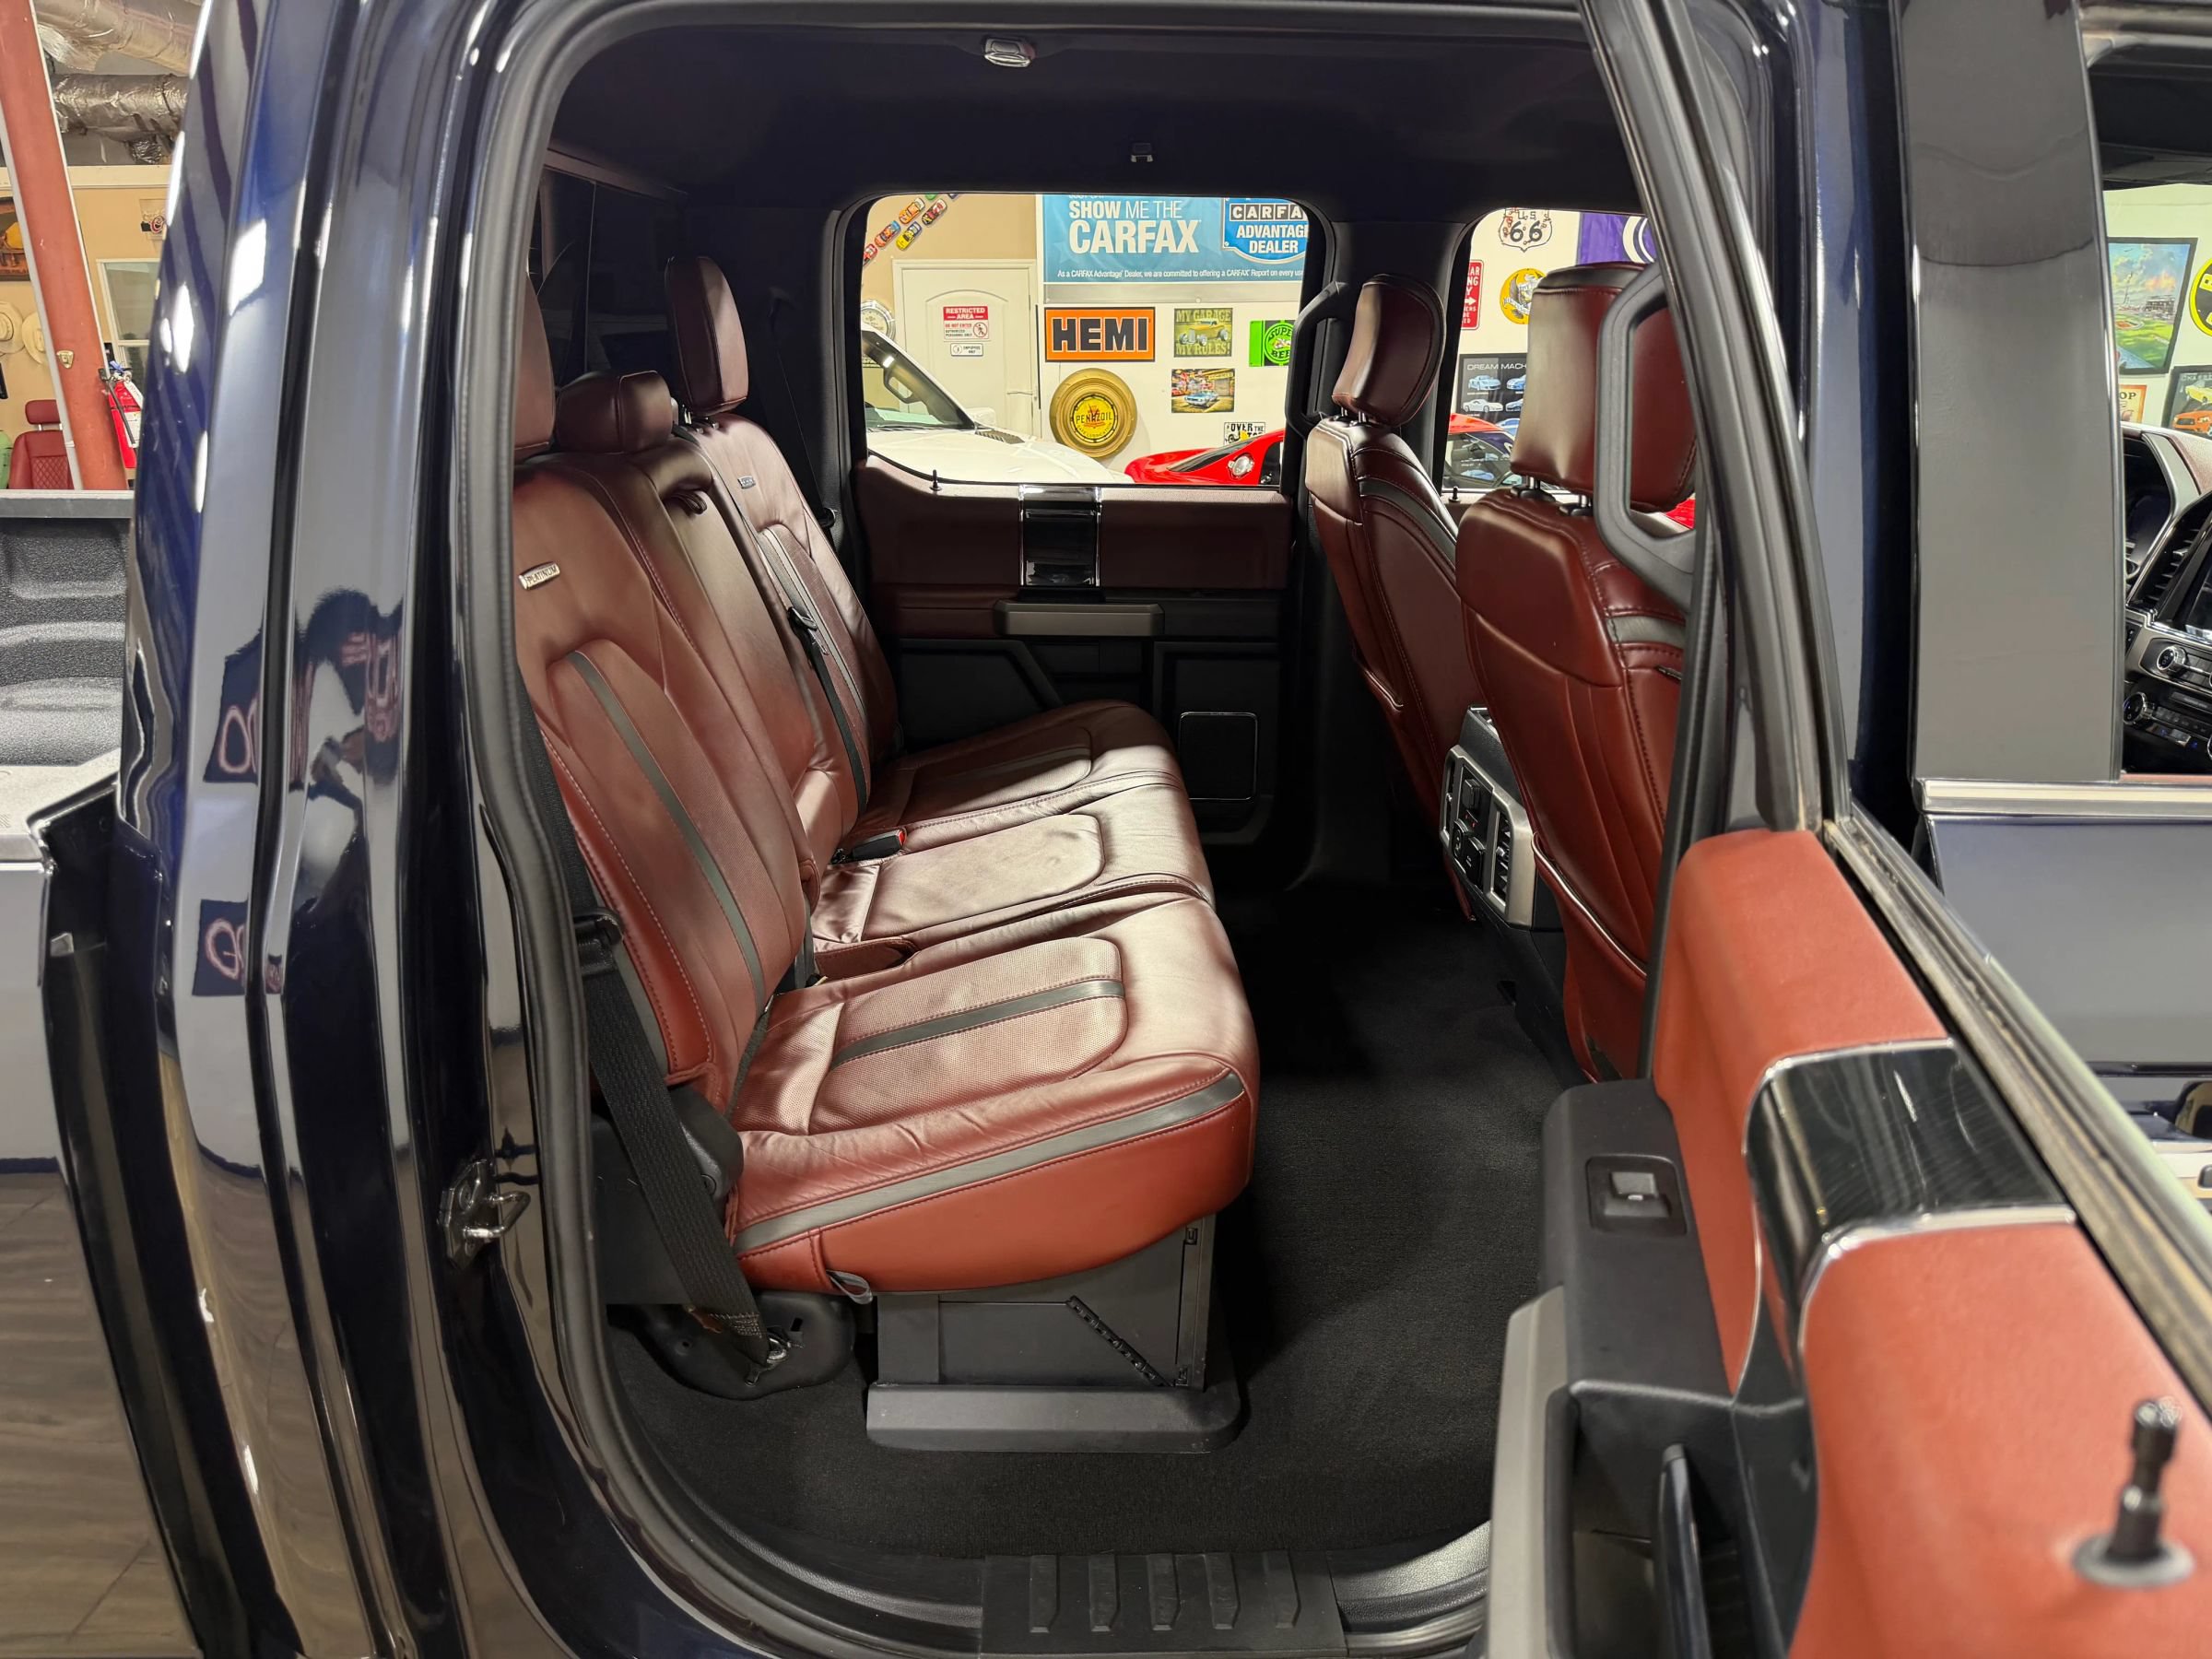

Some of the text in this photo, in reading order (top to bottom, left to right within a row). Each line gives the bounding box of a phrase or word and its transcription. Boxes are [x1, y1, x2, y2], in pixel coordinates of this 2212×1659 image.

[1069, 200, 1182, 218] SHOW ME THE
[1232, 206, 1301, 218] CARFA
[1069, 219, 1200, 254] CARFAX
[1249, 241, 1299, 253] DEALER
[1071, 269, 1093, 277] CARFAX
[1163, 269, 1191, 277] committed
[1199, 269, 1220, 278] offering
[1252, 269, 1270, 278] Report
[1176, 310, 1231, 323] MY GARAGE
[1052, 317, 1148, 352] HEMI
[1268, 327, 1292, 342] SUPE
[1176, 342, 1231, 356] MY RULES!
[2119, 392, 2136, 400] OP
[1076, 412, 1112, 424] PENNZOIL
[1230, 423, 1253, 431] OVER
[526, 565, 557, 583] PLATINUM
